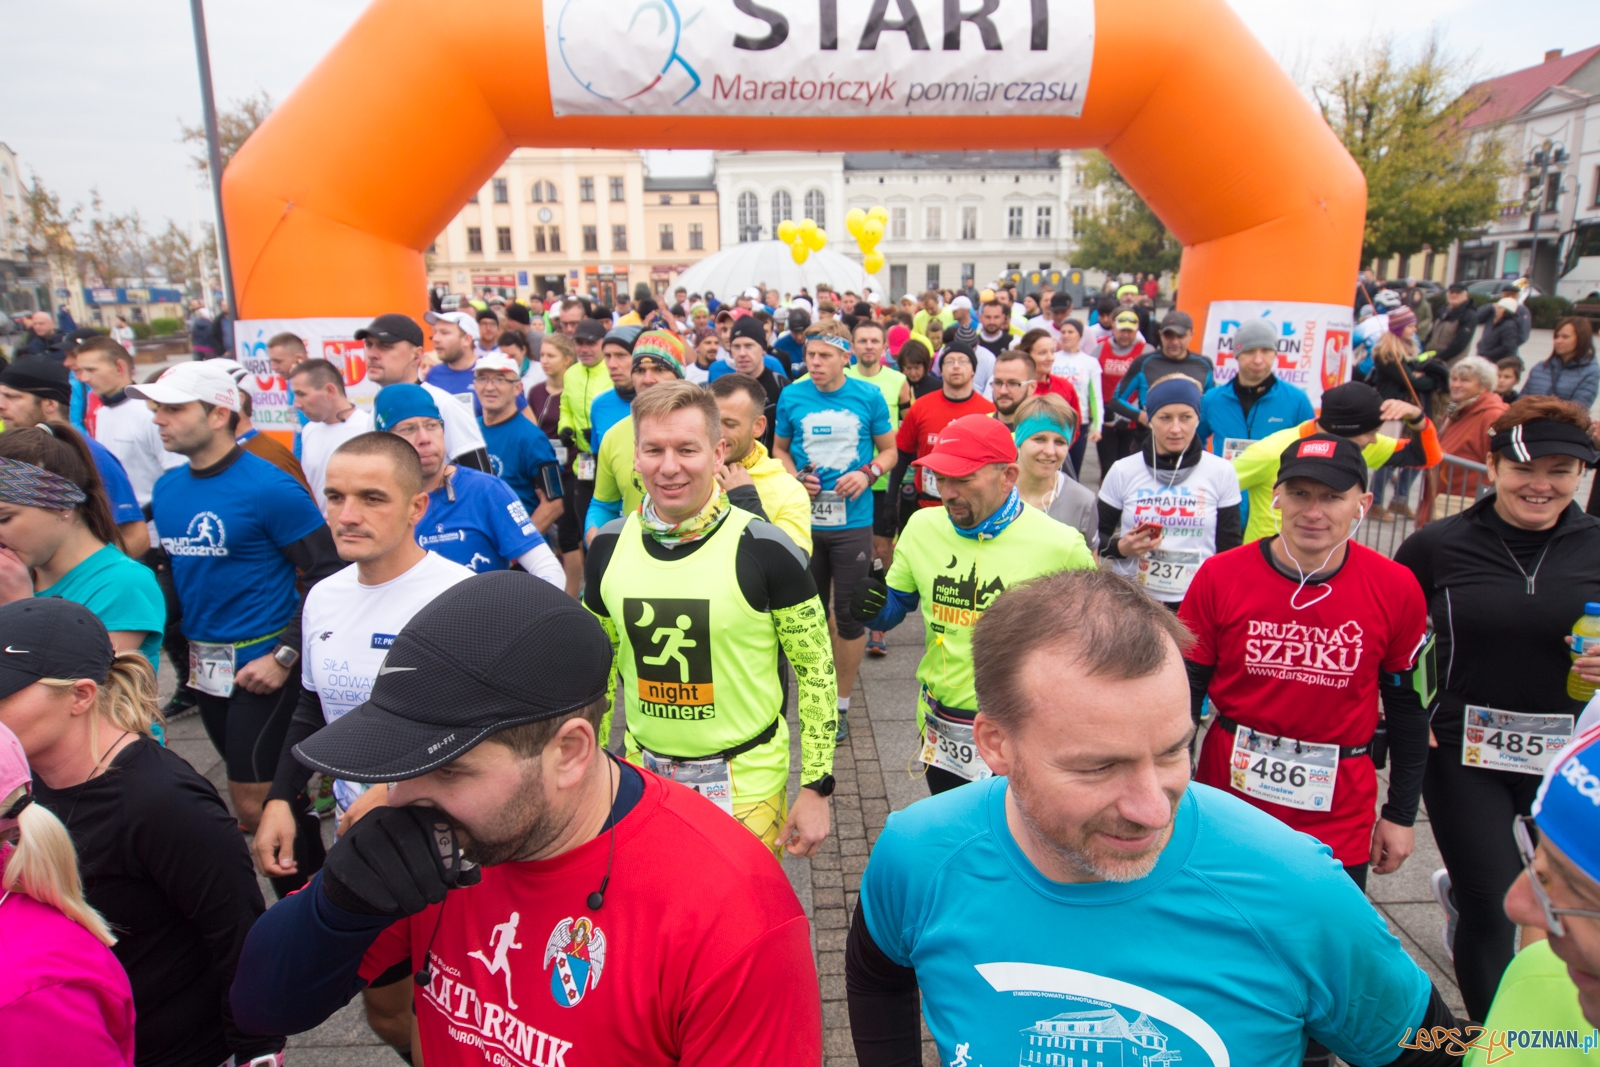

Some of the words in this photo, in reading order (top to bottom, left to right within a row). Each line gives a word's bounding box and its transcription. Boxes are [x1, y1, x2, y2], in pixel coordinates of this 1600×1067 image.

[712, 72, 897, 106] Maratończyk
[905, 75, 1078, 106] pomiarczasu
[811, 503, 833, 515] 244
[1136, 496, 1197, 506] MARATON
[1150, 561, 1184, 579] 237
[936, 584, 959, 596] night
[936, 593, 970, 606] runners
[384, 638, 394, 646] PK
[1247, 620, 1344, 646] DRUŻYNA
[1245, 639, 1364, 671] SZPIKU
[322, 658, 350, 672] SIŁA
[1246, 667, 1349, 689] www.darszpiku.pl
[649, 682, 699, 704] night
[639, 699, 715, 720] runners
[427, 733, 456, 755] DRI-FIT
[939, 735, 973, 764] 339
[1487, 731, 1544, 756] 485
[1251, 757, 1307, 788] 486
[1520, 764, 1544, 772] POLSKA
[1252, 789, 1281, 801] POLINOVA
[1281, 797, 1305, 806] POLSKA
[1065, 994, 1112, 1008] SZAMOTULSKIEGO
